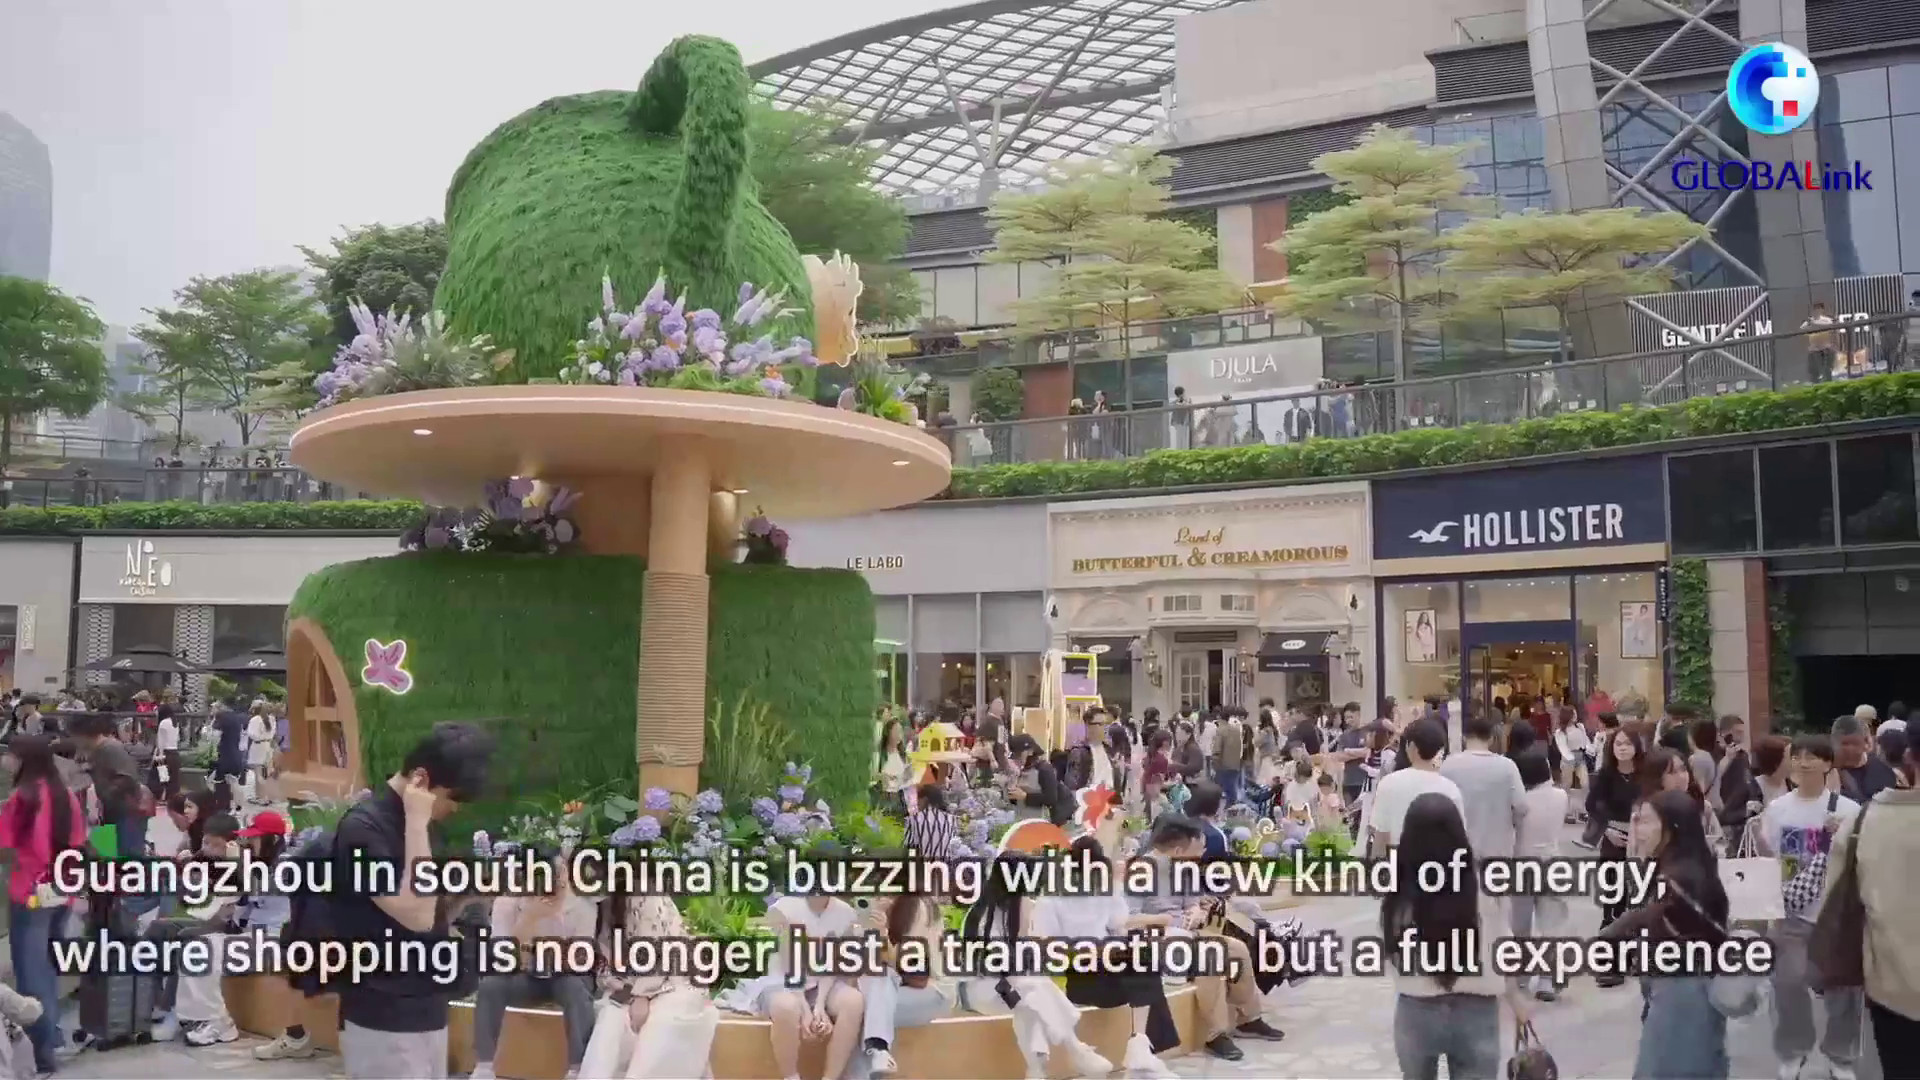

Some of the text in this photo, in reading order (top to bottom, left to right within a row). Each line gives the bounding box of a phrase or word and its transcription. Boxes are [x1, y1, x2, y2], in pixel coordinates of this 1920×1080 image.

[1210, 353, 1278, 379] DJULA
[1173, 525, 1226, 546] Land of
[1463, 503, 1624, 549] HOLLISTER
[846, 555, 904, 569] LE LABO
[1071, 544, 1349, 572] BUTTERFUL & CREAMOROUS
